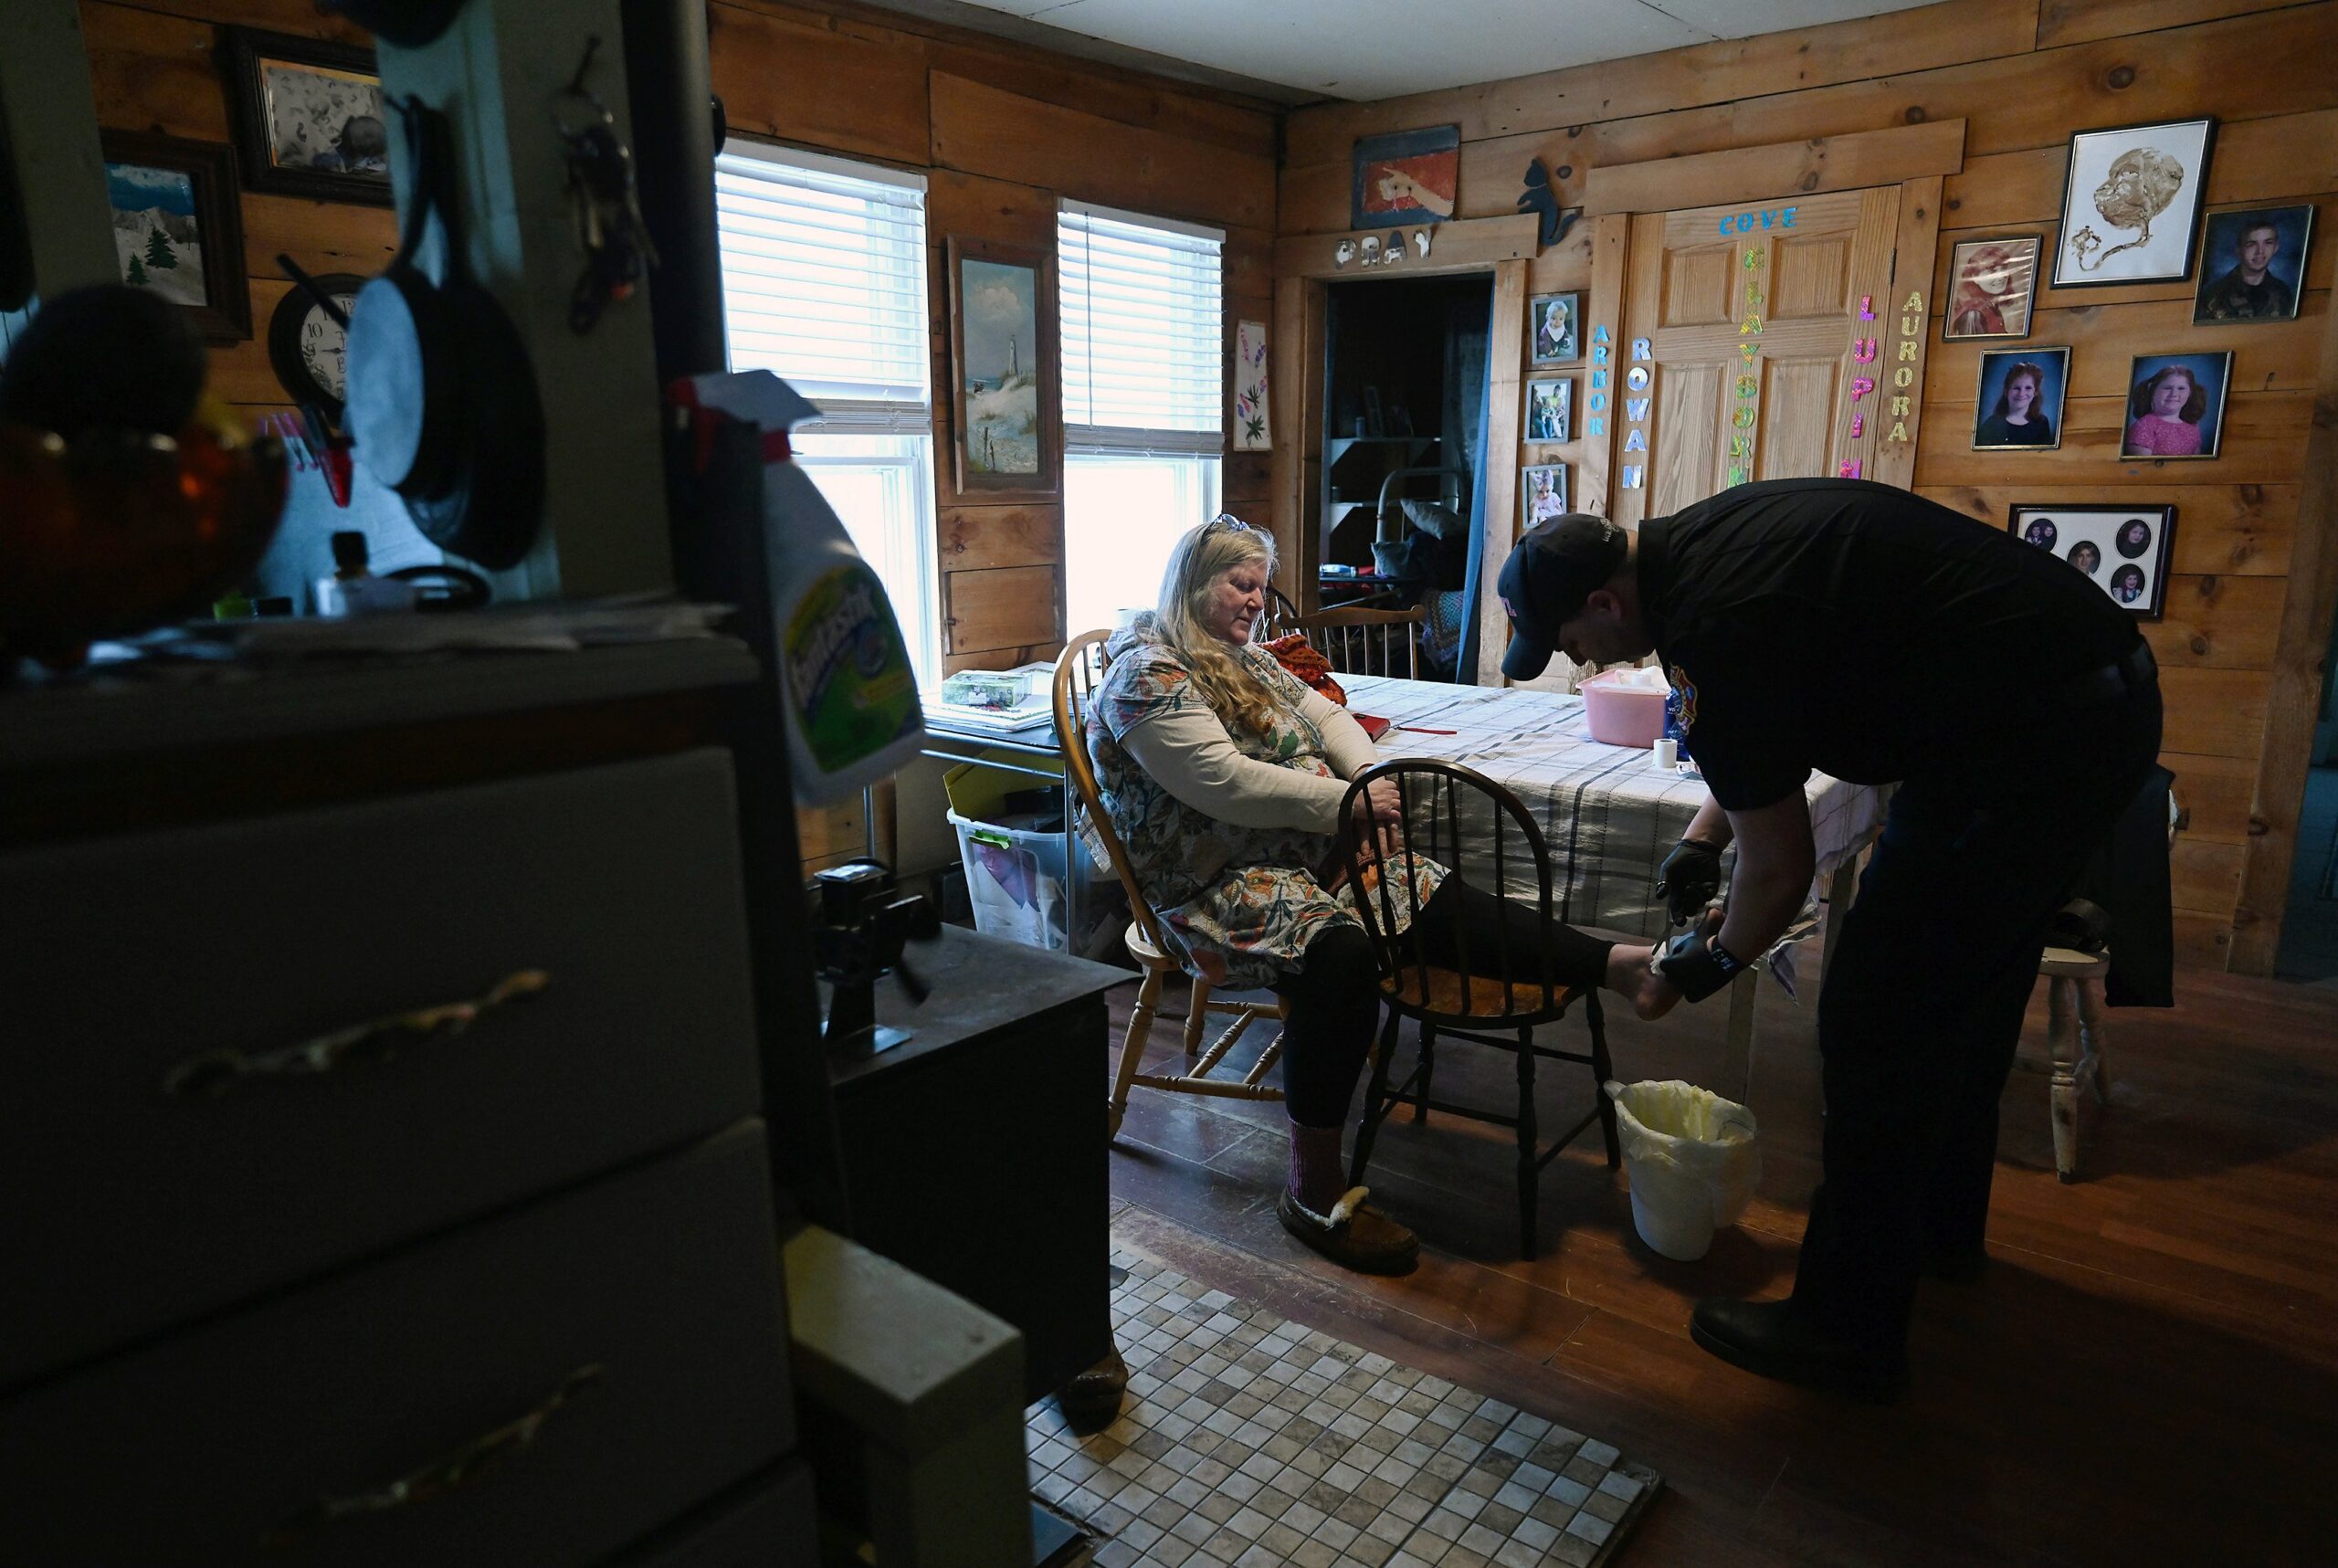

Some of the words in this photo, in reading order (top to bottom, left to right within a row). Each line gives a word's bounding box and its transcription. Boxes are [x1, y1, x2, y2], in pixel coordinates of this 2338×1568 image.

[1334, 229, 1432, 270] PRAY
[1719, 206, 1797, 236] COVE
[308, 322, 322, 338] 10
[1588, 323, 1610, 437] ARBOR
[1840, 295, 1876, 479] LUPIN
[1888, 291, 1923, 441] AURORA
[1622, 337, 1652, 489] ROWAN
